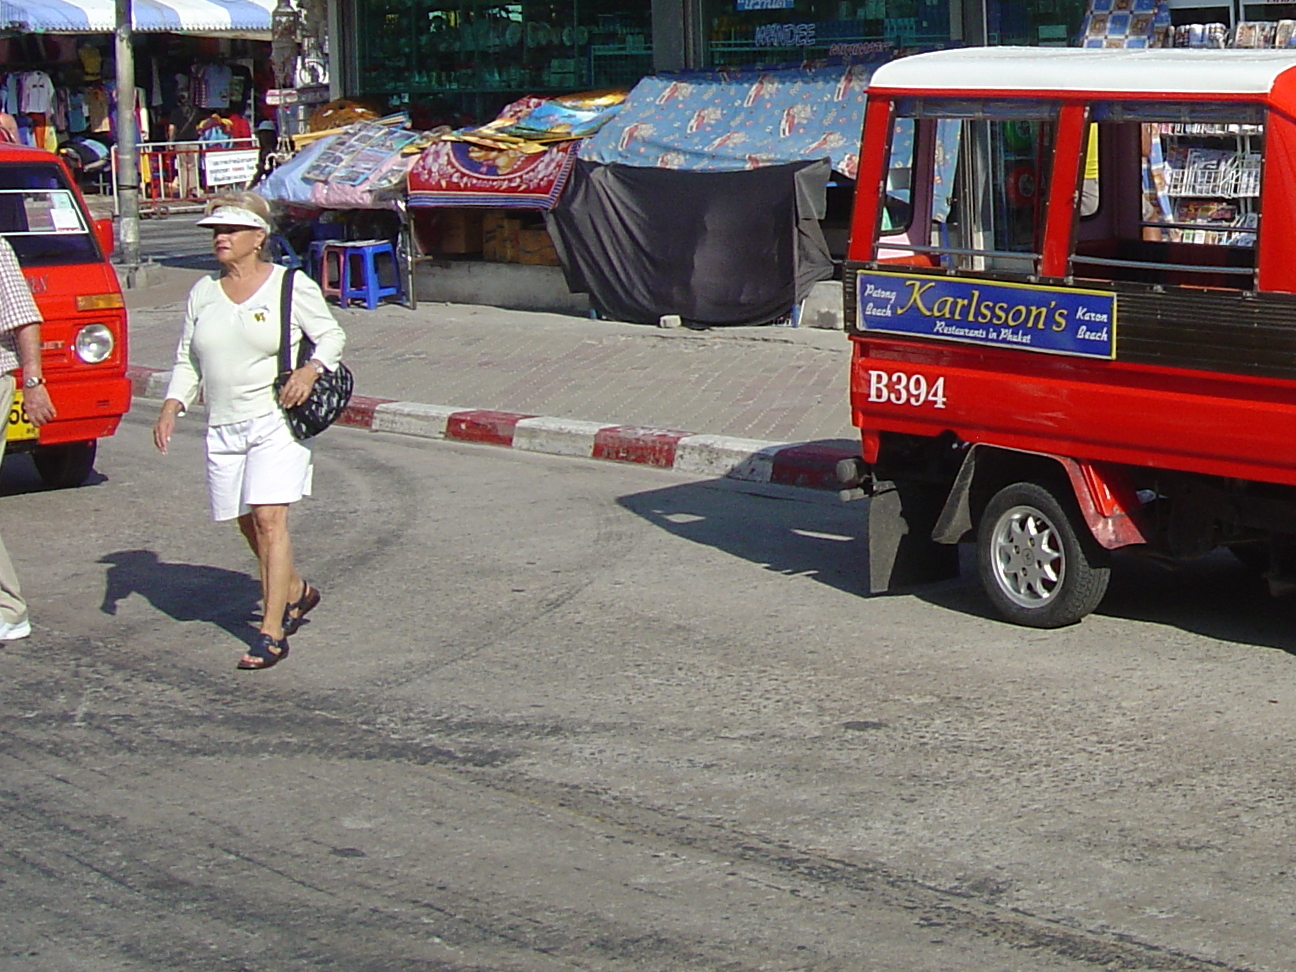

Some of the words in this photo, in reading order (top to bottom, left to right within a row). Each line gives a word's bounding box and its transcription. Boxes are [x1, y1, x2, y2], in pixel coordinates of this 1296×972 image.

[864, 284, 897, 303] Patong
[865, 303, 892, 317] Beach
[897, 280, 1068, 332] Karlsson's
[1076, 306, 1108, 323] Karon
[934, 320, 987, 339] Restaurants
[989, 329, 998, 340] in
[999, 329, 1032, 344] Phuket
[1076, 325, 1108, 342] Beach
[867, 369, 947, 409] B394
